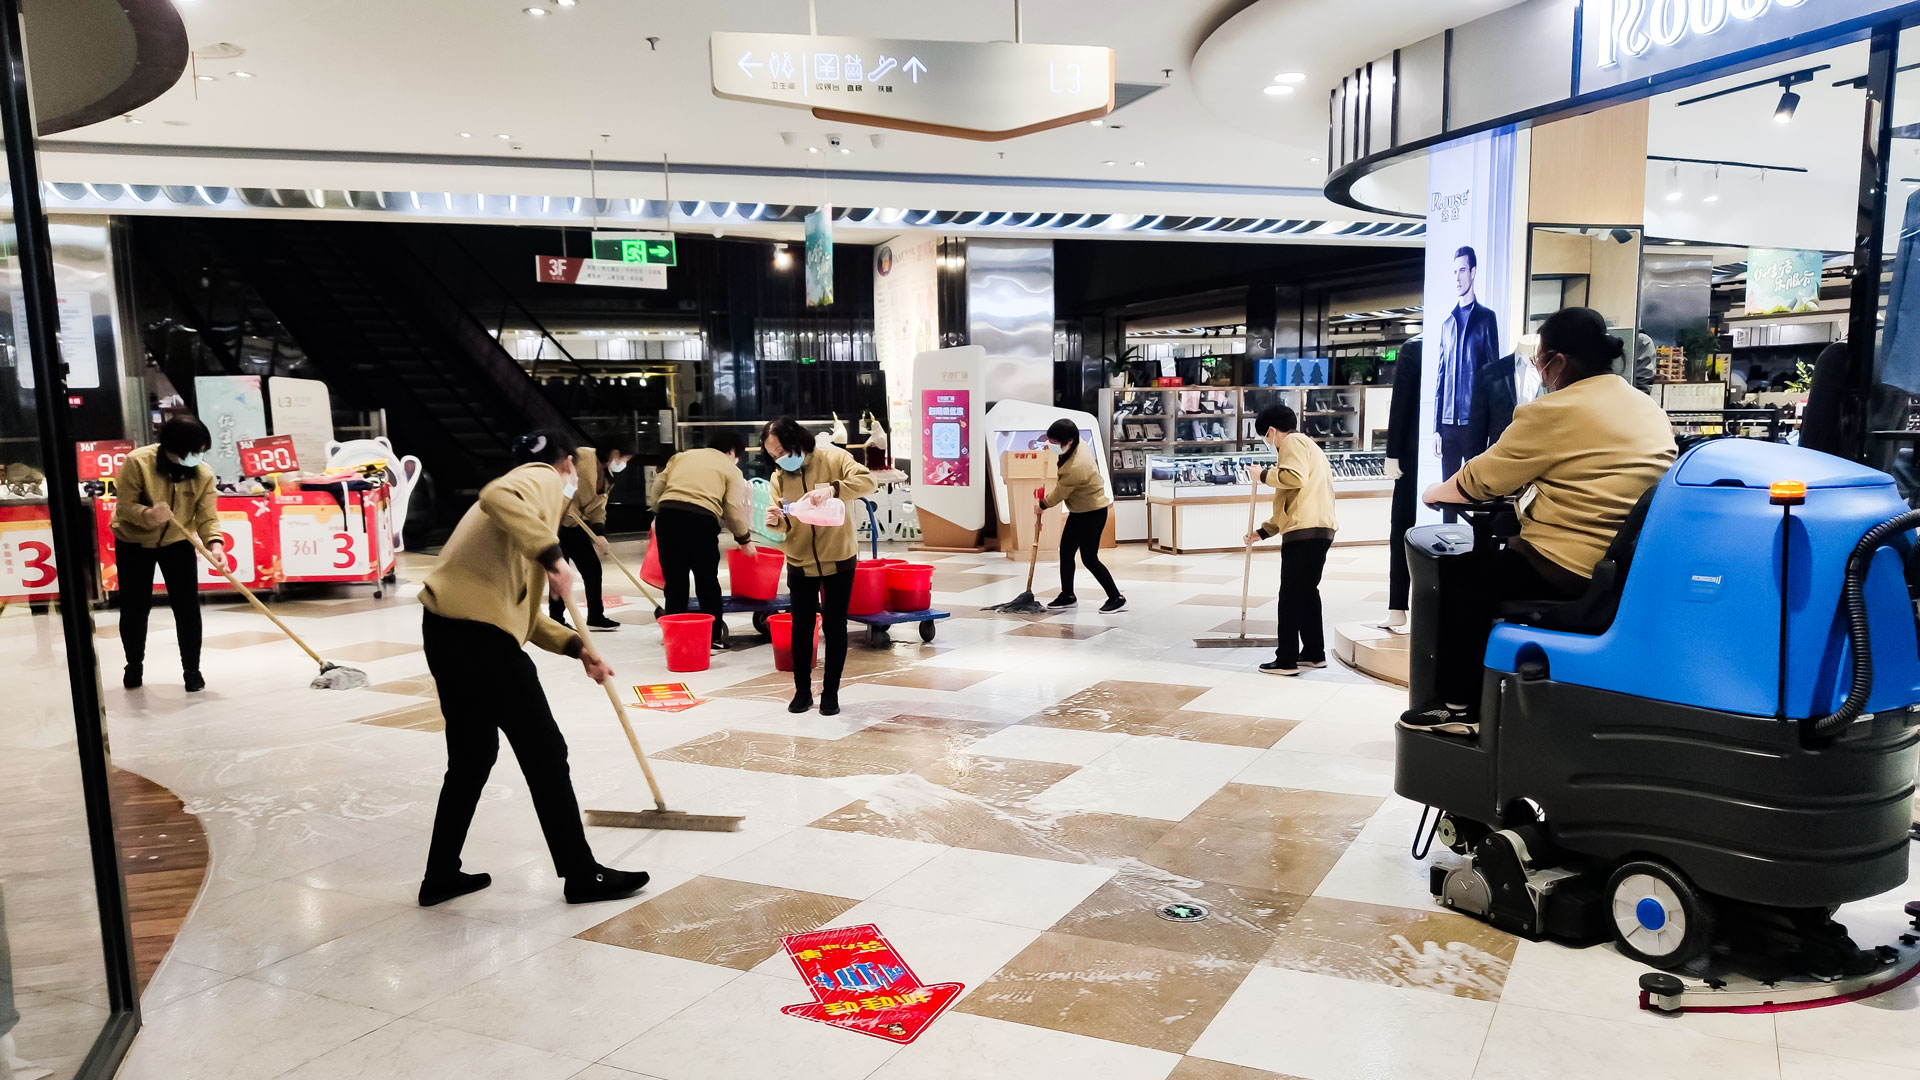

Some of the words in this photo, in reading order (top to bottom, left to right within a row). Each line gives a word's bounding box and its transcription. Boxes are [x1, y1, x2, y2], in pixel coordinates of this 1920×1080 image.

[1596, 0, 1809, 69] Rou
[1049, 60, 1081, 95] L3
[1431, 191, 1468, 212] Rouse
[549, 259, 567, 276] 3F
[252, 447, 292, 472] 120
[18, 540, 58, 588] 3
[333, 532, 357, 569] 3
[822, 990, 934, 1016] 抓娃娃
